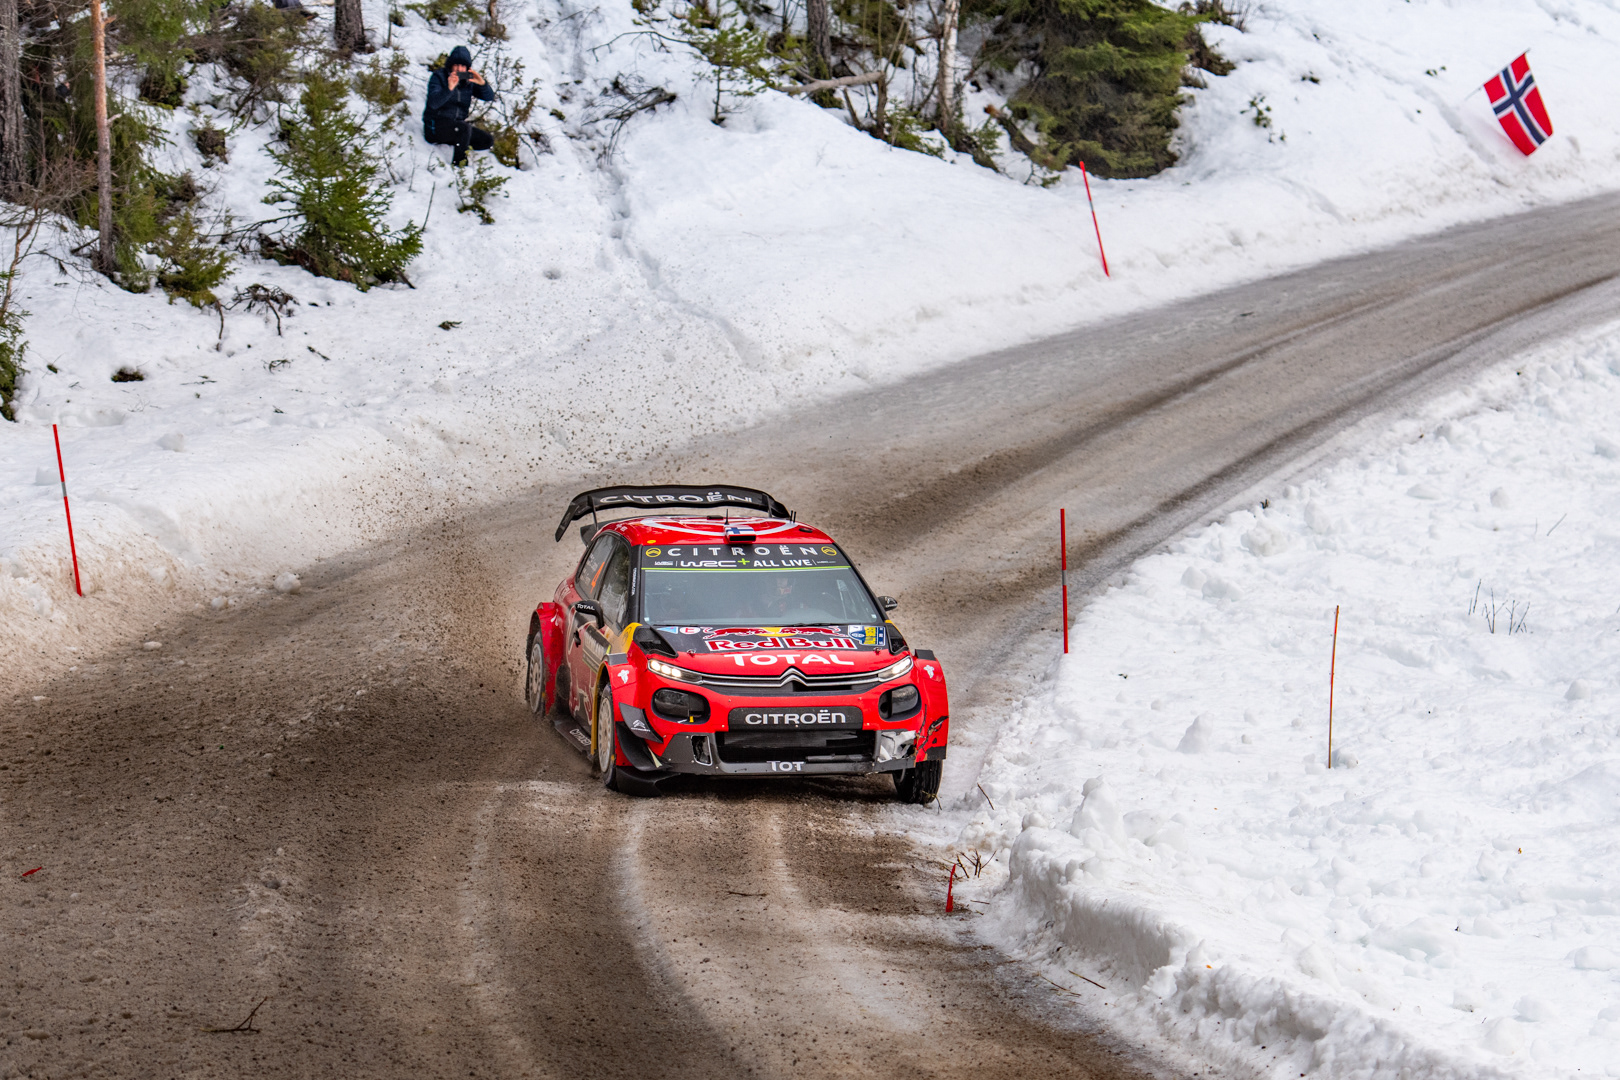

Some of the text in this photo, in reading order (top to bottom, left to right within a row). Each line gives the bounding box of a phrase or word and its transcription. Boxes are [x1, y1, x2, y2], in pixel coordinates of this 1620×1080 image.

[600, 491, 752, 503] CITROËN
[667, 545, 818, 556] CITROËN
[781, 559, 813, 567] LIVE
[577, 603, 595, 611] TOTAL
[705, 636, 858, 651] Red Bull
[724, 653, 855, 666] TOTAL
[745, 709, 846, 725] CITROËN
